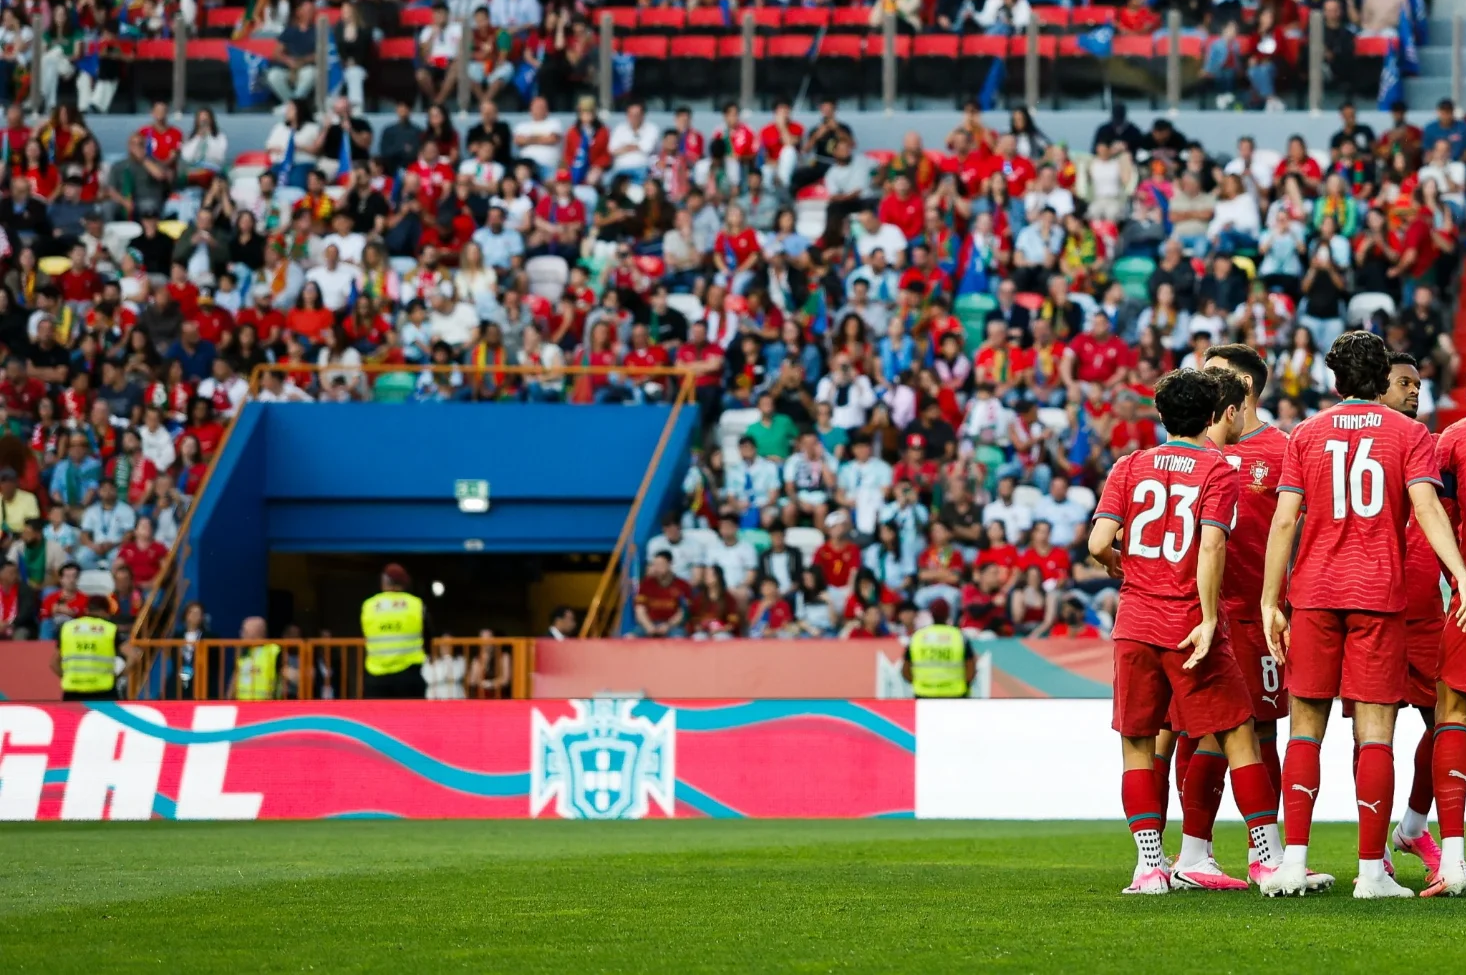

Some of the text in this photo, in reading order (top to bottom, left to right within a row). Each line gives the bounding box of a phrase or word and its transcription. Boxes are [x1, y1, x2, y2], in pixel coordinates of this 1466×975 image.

[1332, 412, 1382, 430] TRINCÃO
[1153, 454, 1196, 474] VITINHA
[1325, 438, 1385, 520] 16
[1128, 479, 1200, 563] 23
[1260, 655, 1279, 693] 8
